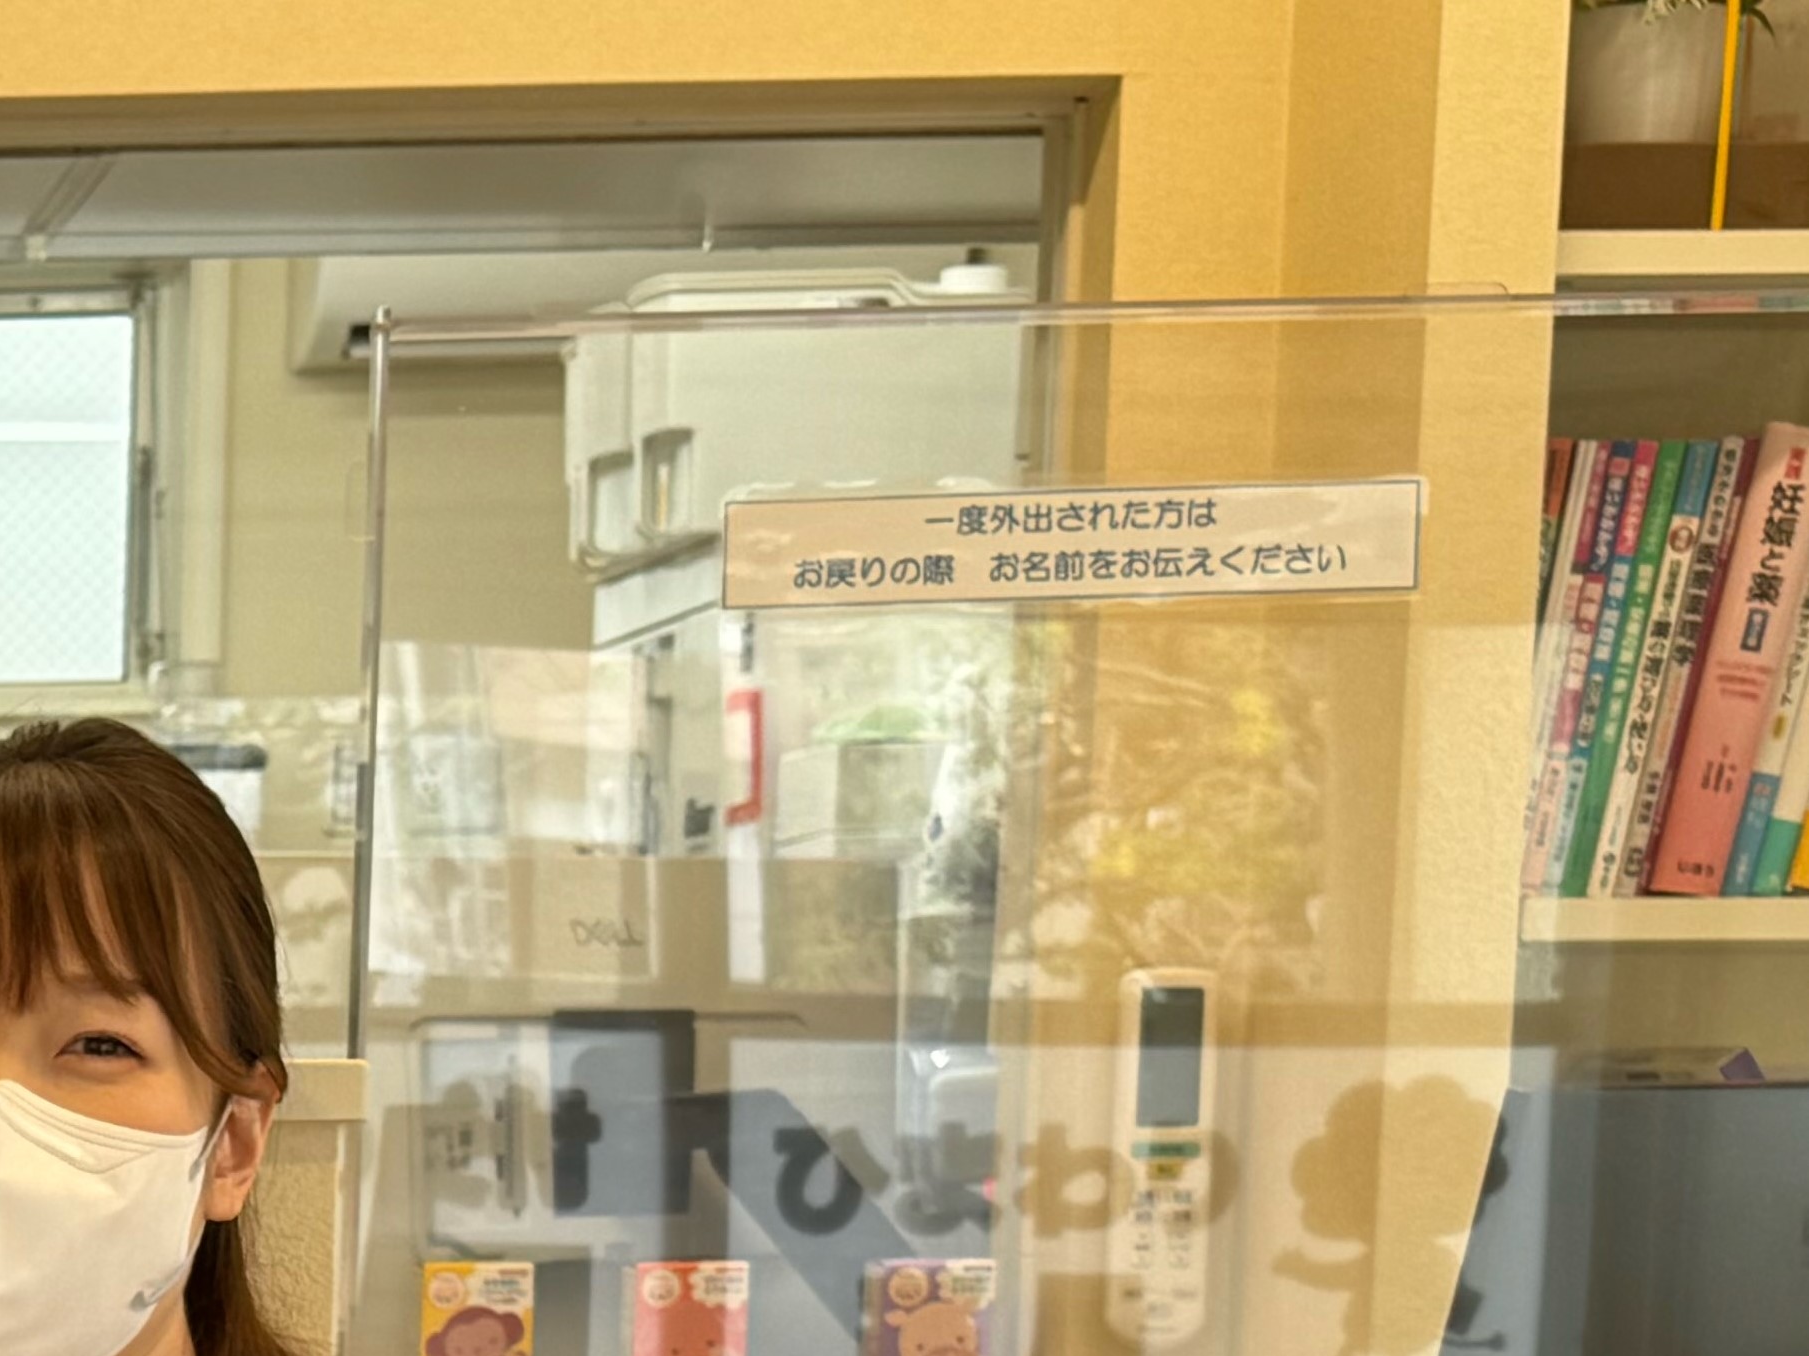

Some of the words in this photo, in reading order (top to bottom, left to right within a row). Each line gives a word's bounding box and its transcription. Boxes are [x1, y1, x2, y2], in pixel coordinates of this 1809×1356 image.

[924, 497, 1217, 535] 一度外出された方は
[792, 552, 956, 589] お戻りの際
[988, 543, 1347, 584] お名前をお伝えください
